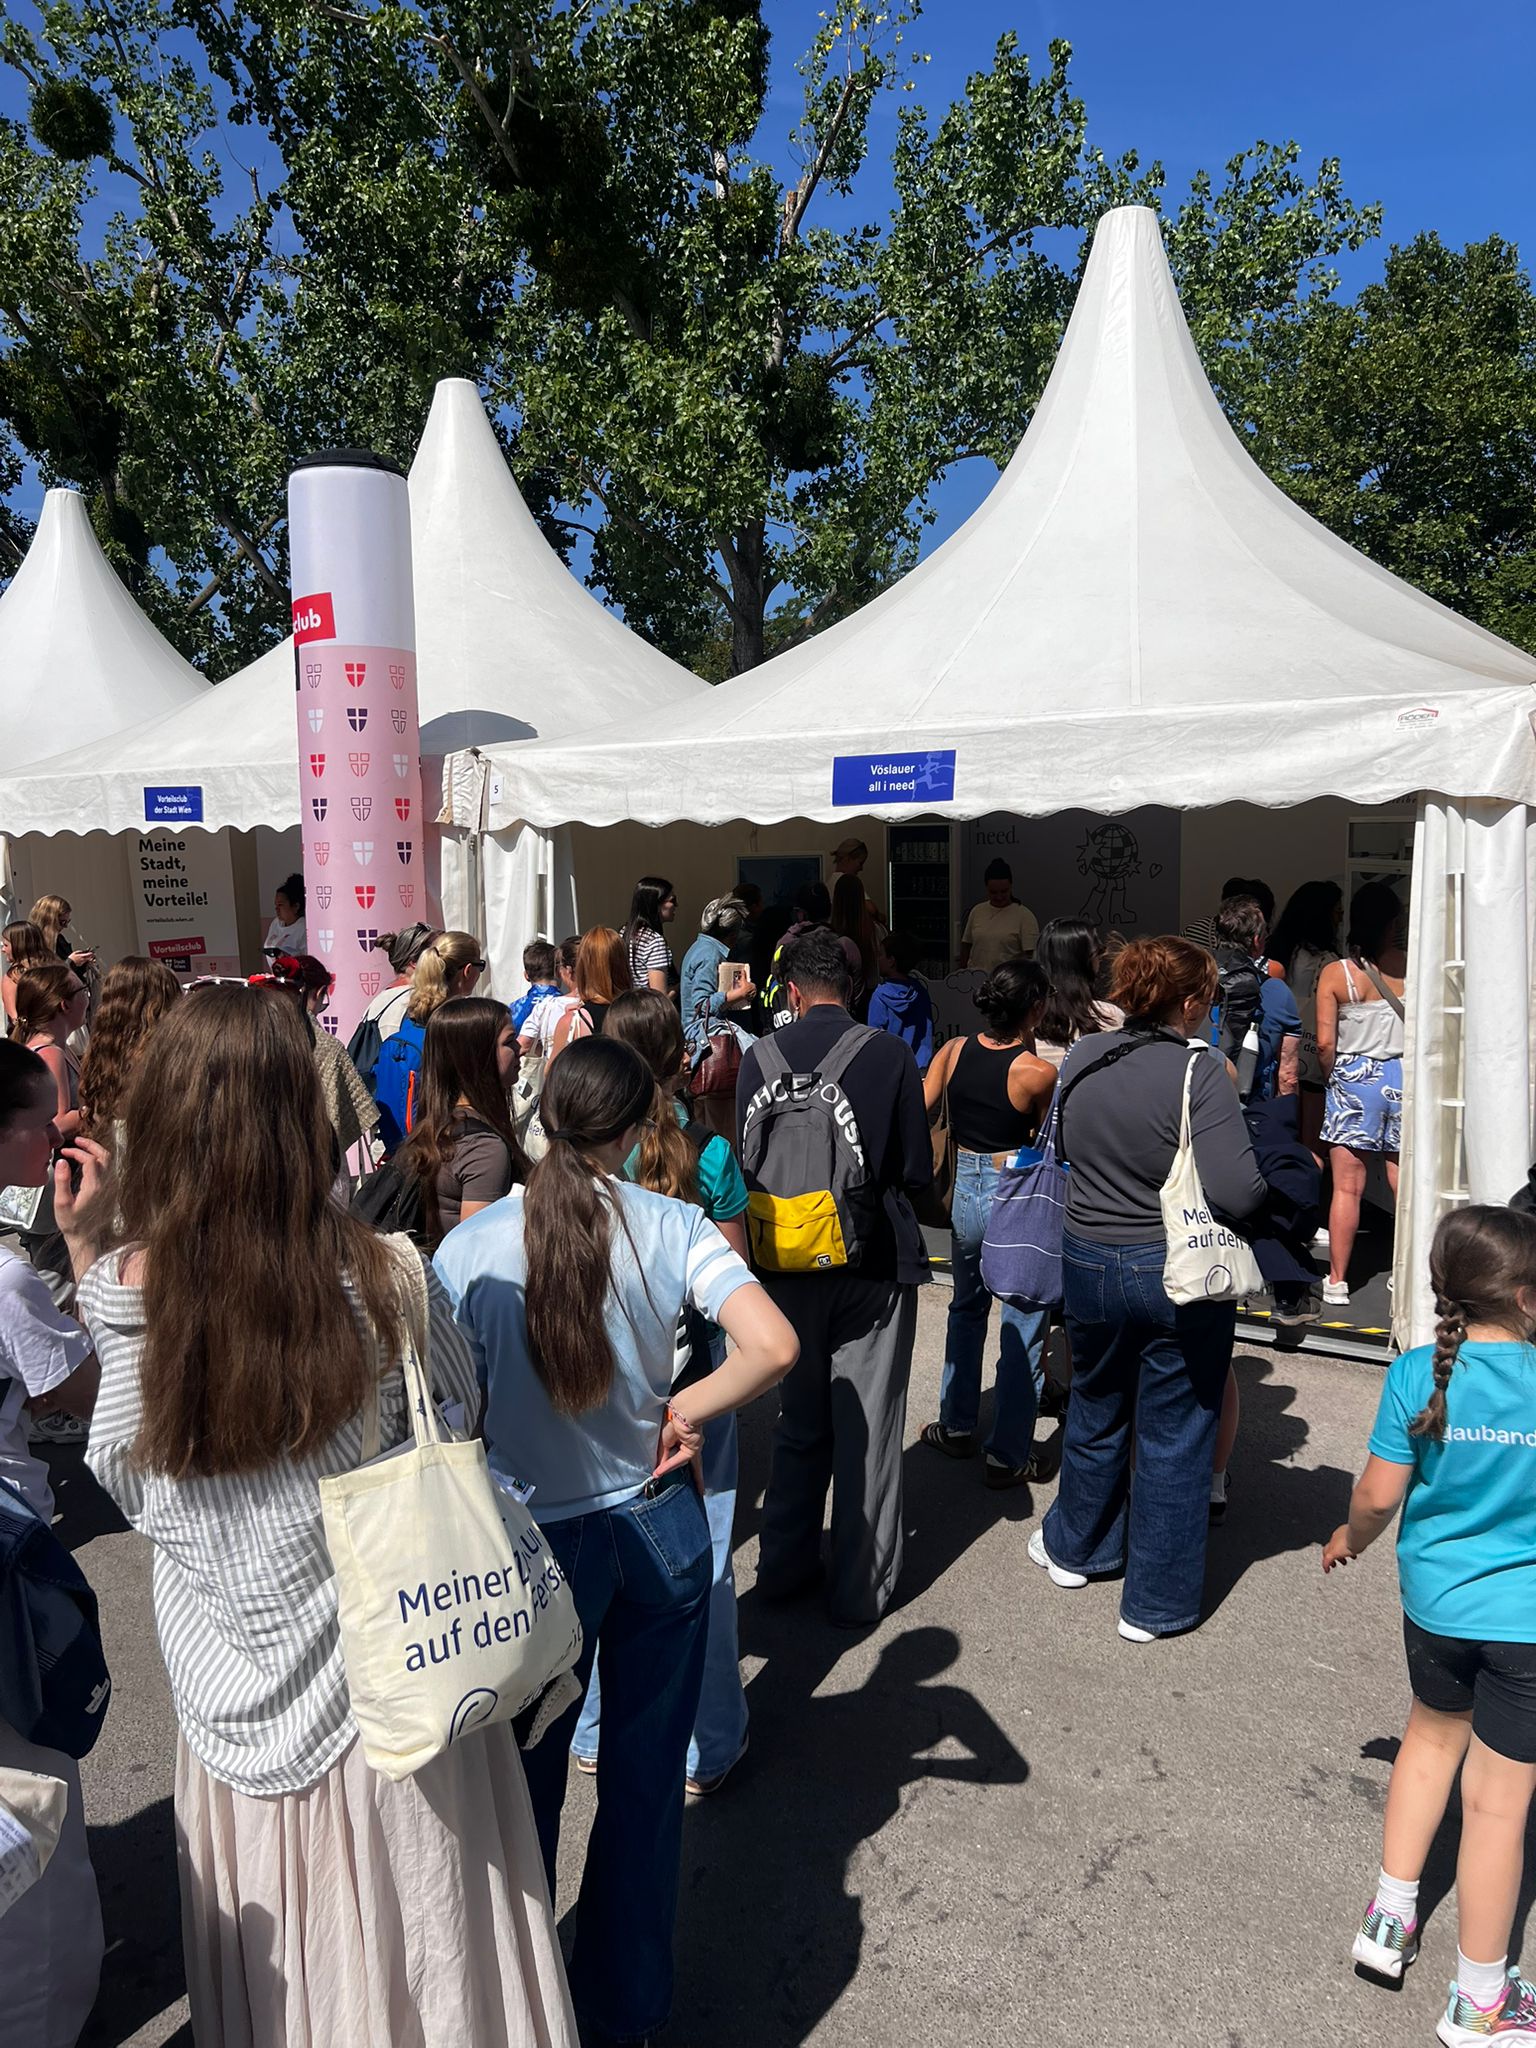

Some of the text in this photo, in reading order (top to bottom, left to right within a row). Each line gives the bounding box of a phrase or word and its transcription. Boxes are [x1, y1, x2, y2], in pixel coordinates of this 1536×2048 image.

[870, 763, 916, 776] Vöslauer
[494, 784, 499, 794] 5
[868, 779, 915, 792] all i need
[178, 805, 192, 814] Wien
[976, 824, 1020, 845] need.
[139, 838, 186, 852] Meine
[140, 856, 186, 872] Stadt,
[143, 875, 188, 889] meine
[144, 892, 209, 907] Vorteile!
[153, 941, 202, 954] Vorteilsclub
[1187, 1228, 1214, 1249] auf
[398, 1566, 513, 1624] Meiner
[405, 1617, 462, 1672] auf
[473, 1610, 531, 1649] den
